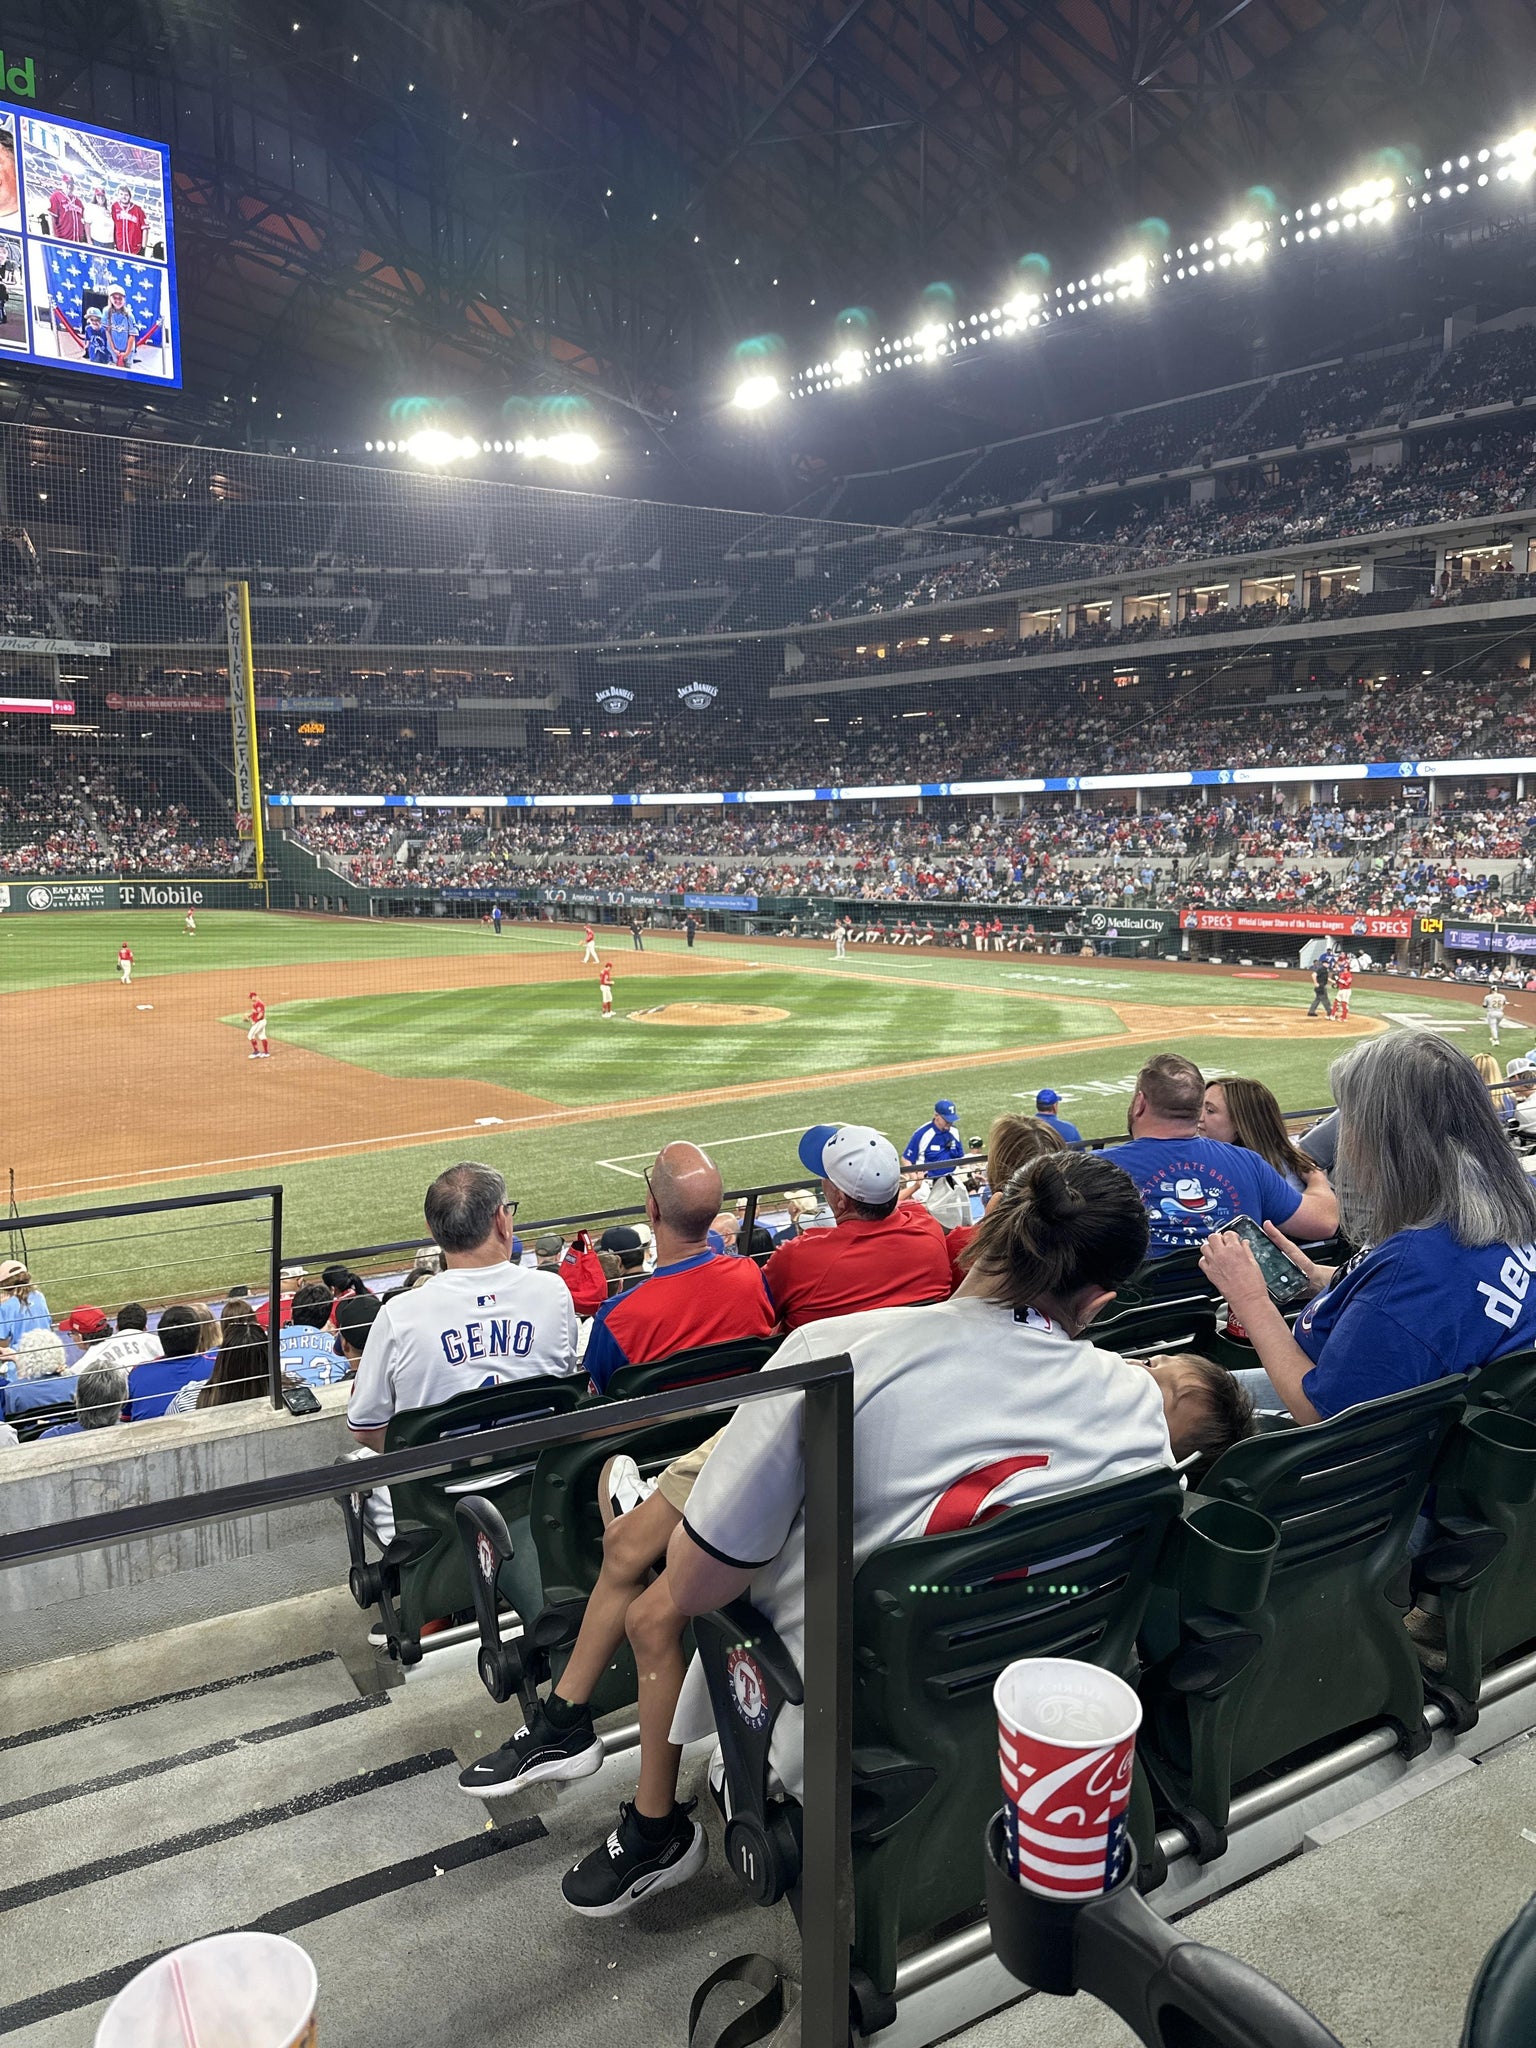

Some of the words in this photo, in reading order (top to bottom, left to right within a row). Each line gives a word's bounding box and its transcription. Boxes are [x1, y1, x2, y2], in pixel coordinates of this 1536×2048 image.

[595, 689, 610, 702] JACK
[677, 684, 693, 698] JACK
[230, 616, 243, 702] CHIKIN
[238, 749, 250, 806] FARE
[67, 893, 90, 901] A&M
[76, 886, 104, 894] TEXAS
[140, 887, 203, 904] Mobile
[572, 893, 595, 902] American
[630, 895, 655, 904] American
[1107, 917, 1144, 930] Medical
[1144, 919, 1164, 932] City
[1201, 914, 1232, 927] SPEC'S
[1238, 917, 1257, 926] Official
[1371, 920, 1408, 934] SPEC'S
[1169, 1161, 1205, 1172] STATE
[1209, 1168, 1242, 1214] BASEBAL
[441, 1320, 535, 1366] GENO
[741, 1845, 754, 1881] 11
